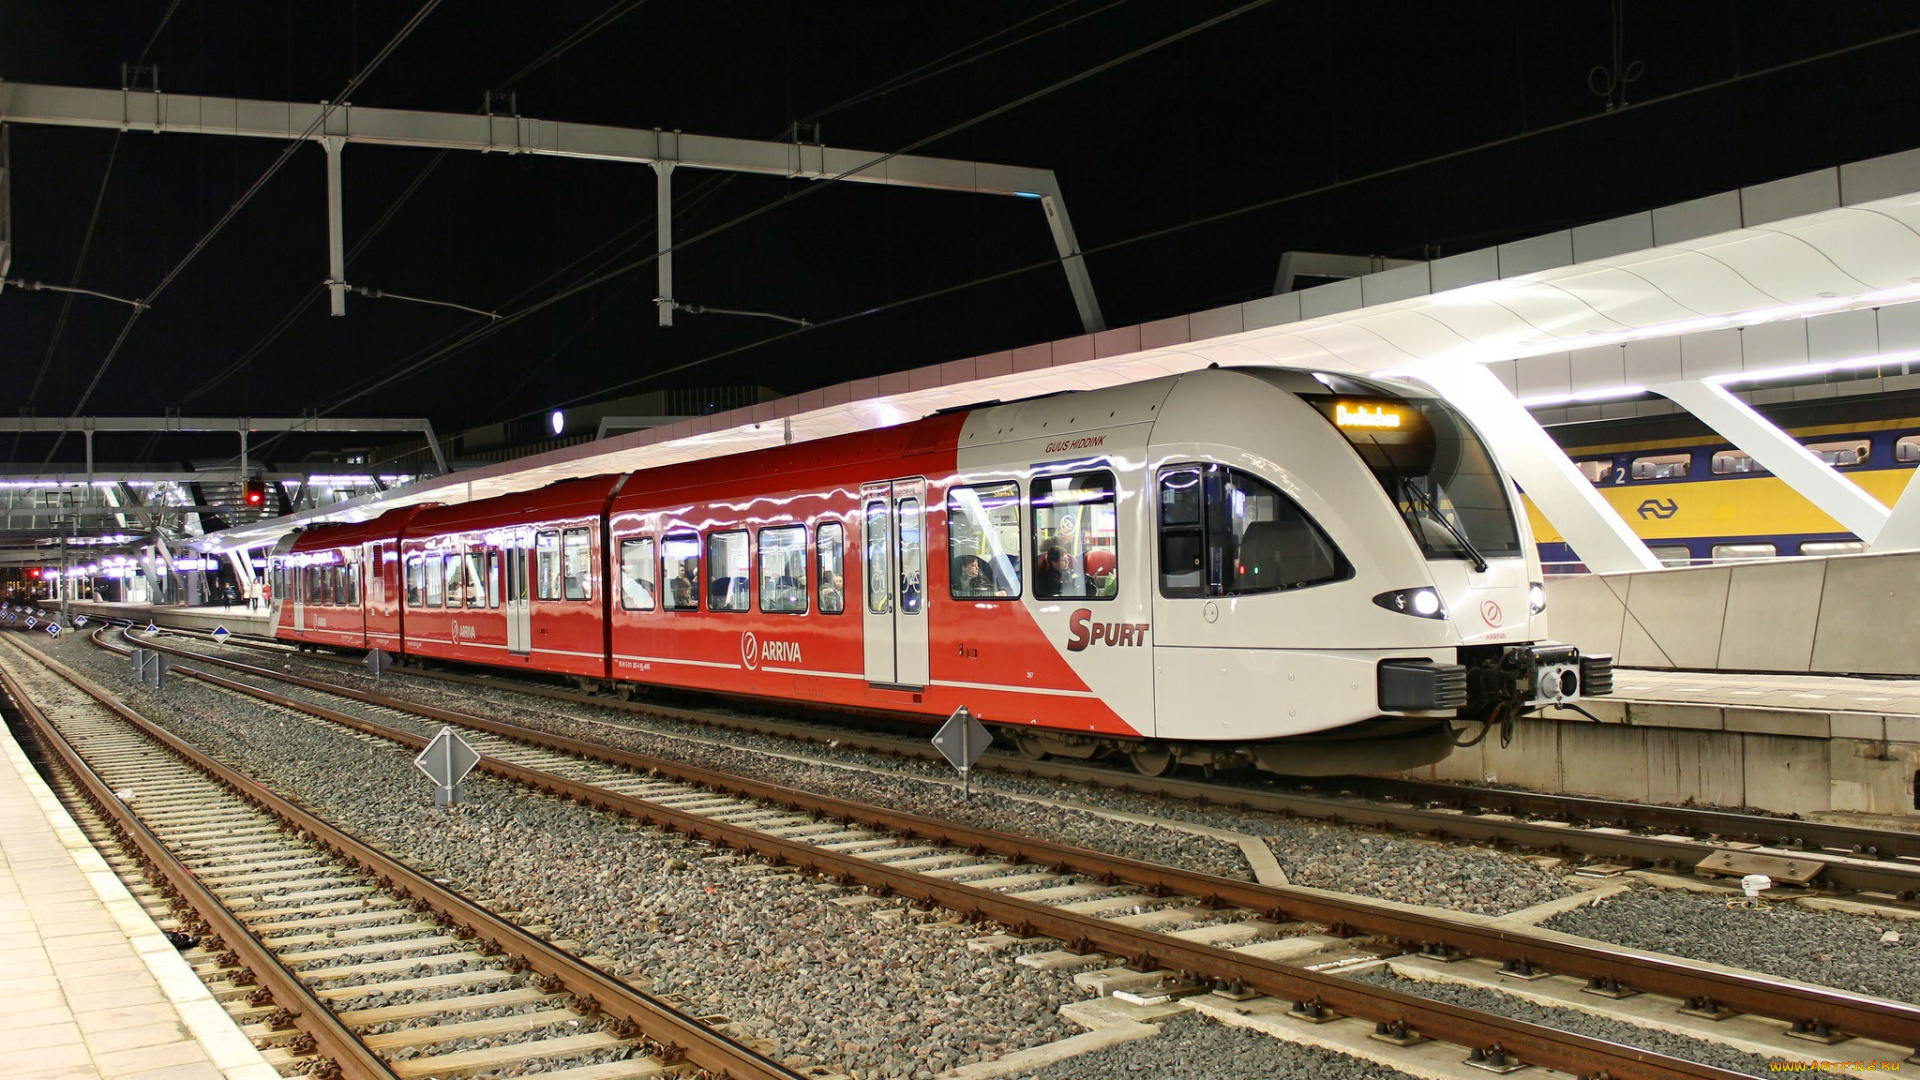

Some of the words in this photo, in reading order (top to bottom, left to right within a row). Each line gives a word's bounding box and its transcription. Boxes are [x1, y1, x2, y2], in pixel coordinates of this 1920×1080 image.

[1045, 440, 1070, 453] GUUS
[1070, 435, 1106, 450] HIDDINK
[1615, 467, 1626, 484] 2
[761, 640, 802, 663] ARRIVA
